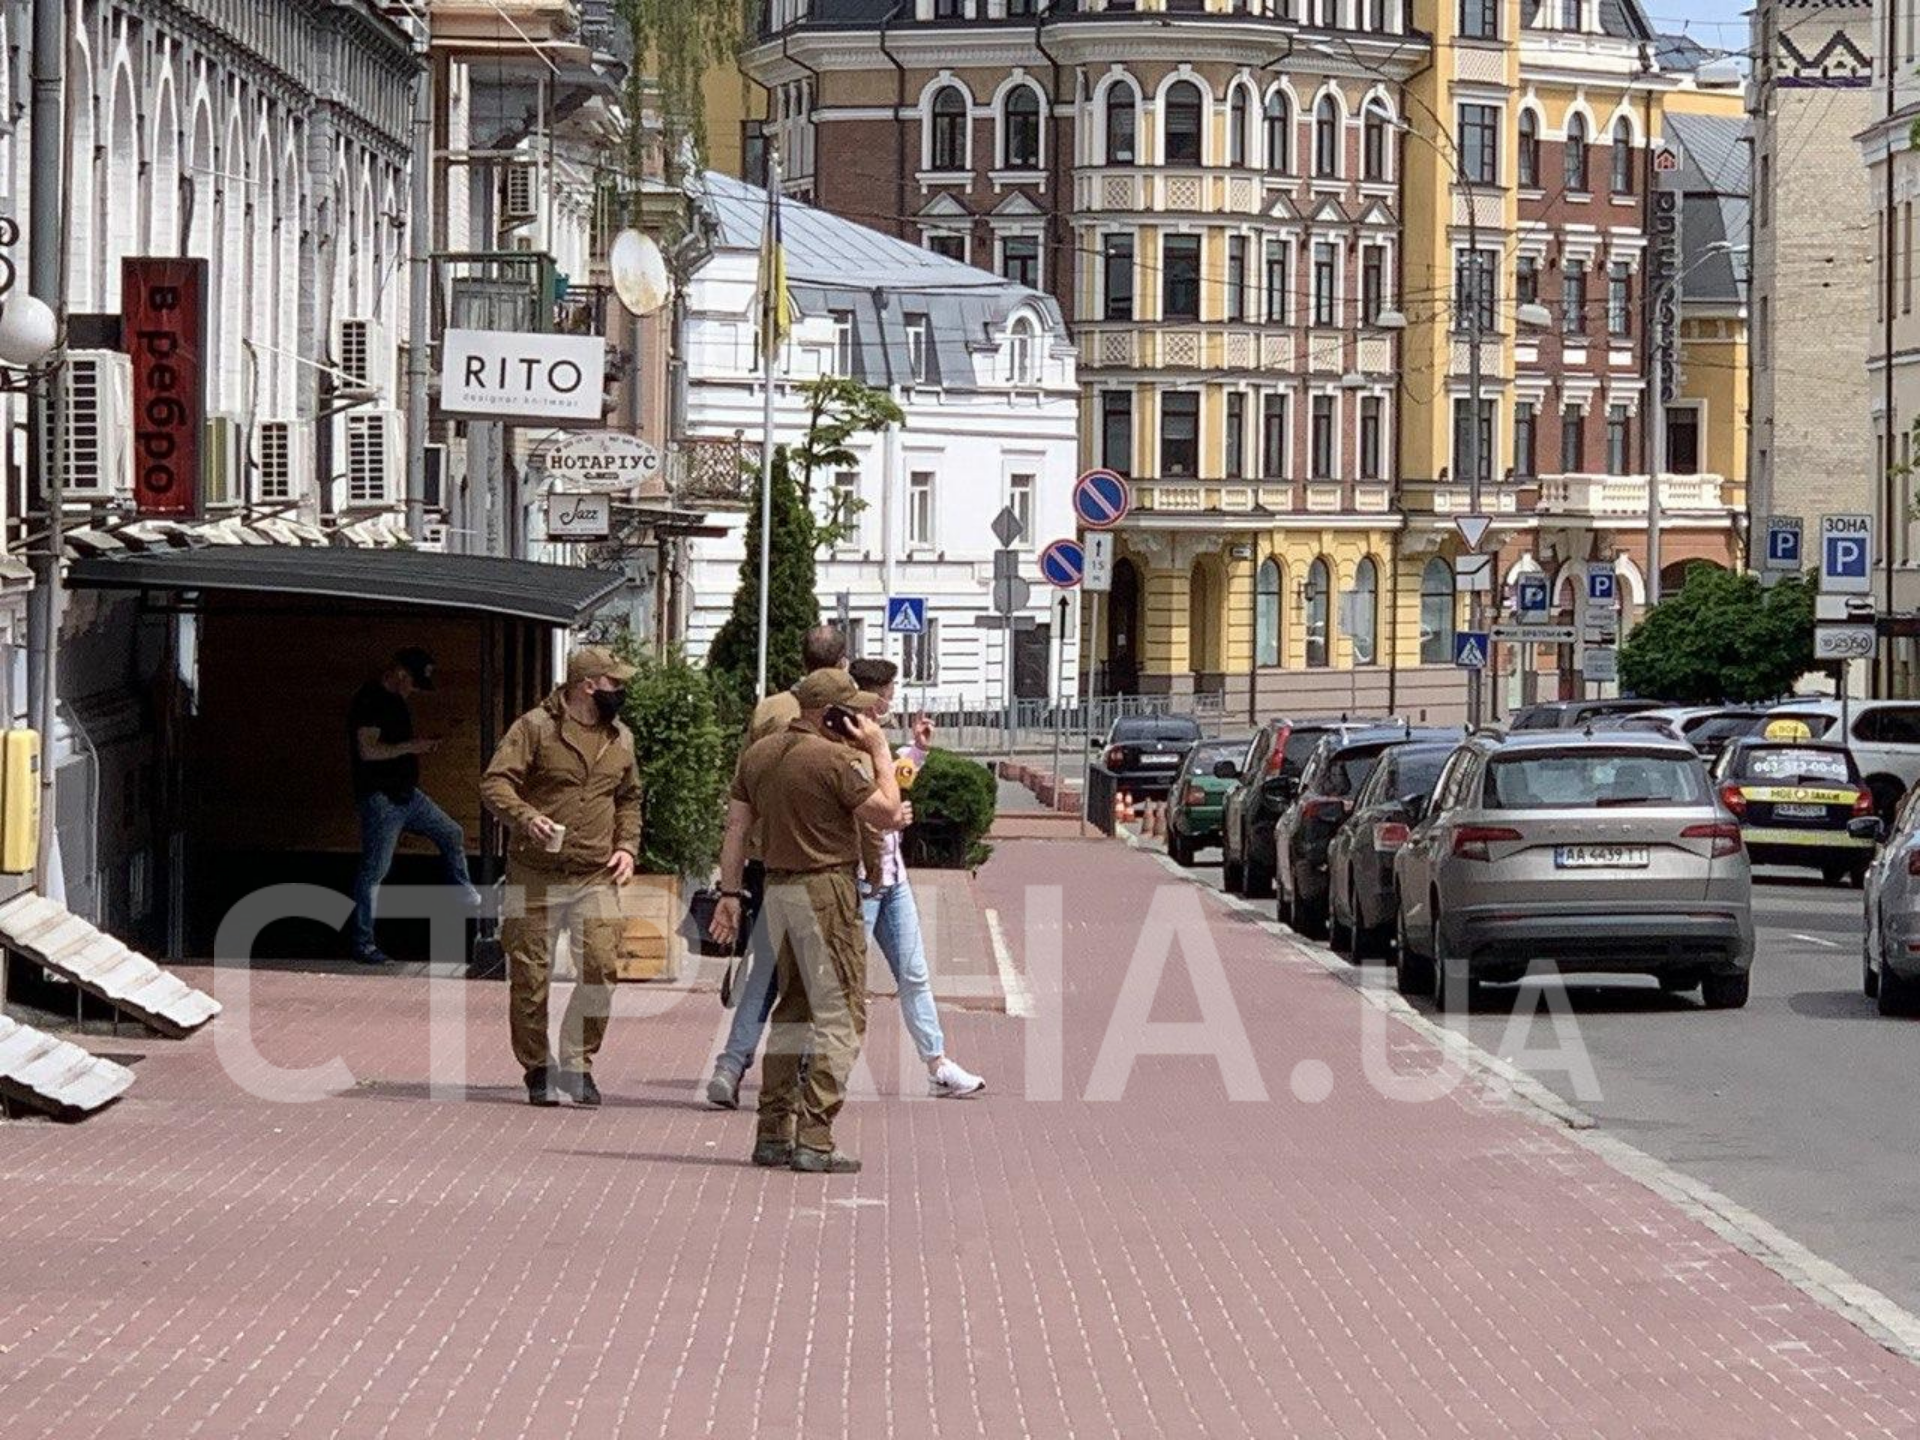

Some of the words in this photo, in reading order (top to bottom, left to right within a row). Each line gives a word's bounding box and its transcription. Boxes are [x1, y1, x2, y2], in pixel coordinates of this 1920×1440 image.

[464, 355, 582, 394] RITO
[551, 455, 656, 469] НОТАРІУС
[559, 498, 598, 525] Jazz
[1825, 518, 1868, 532] ЗОНА
[1567, 847, 1586, 861] AA
